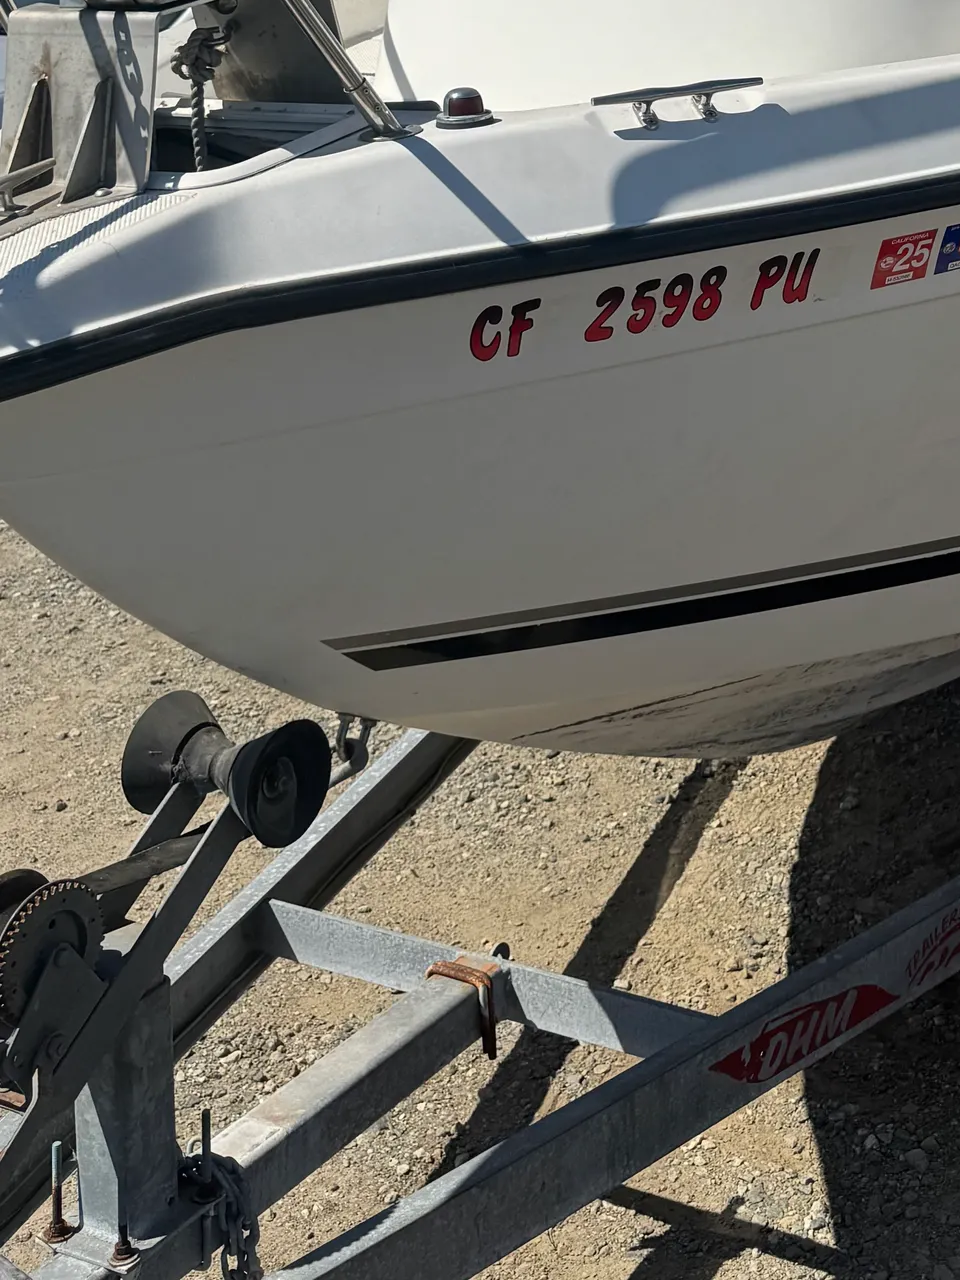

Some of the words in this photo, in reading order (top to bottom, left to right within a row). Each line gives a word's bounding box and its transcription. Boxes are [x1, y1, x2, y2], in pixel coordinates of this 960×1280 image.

[891, 232, 929, 245] CALIFORNIA
[892, 238, 933, 272] 25
[469, 298, 541, 362] CF
[584, 265, 727, 342] 2598
[750, 248, 820, 311] PU
[757, 987, 858, 1081] DHM
